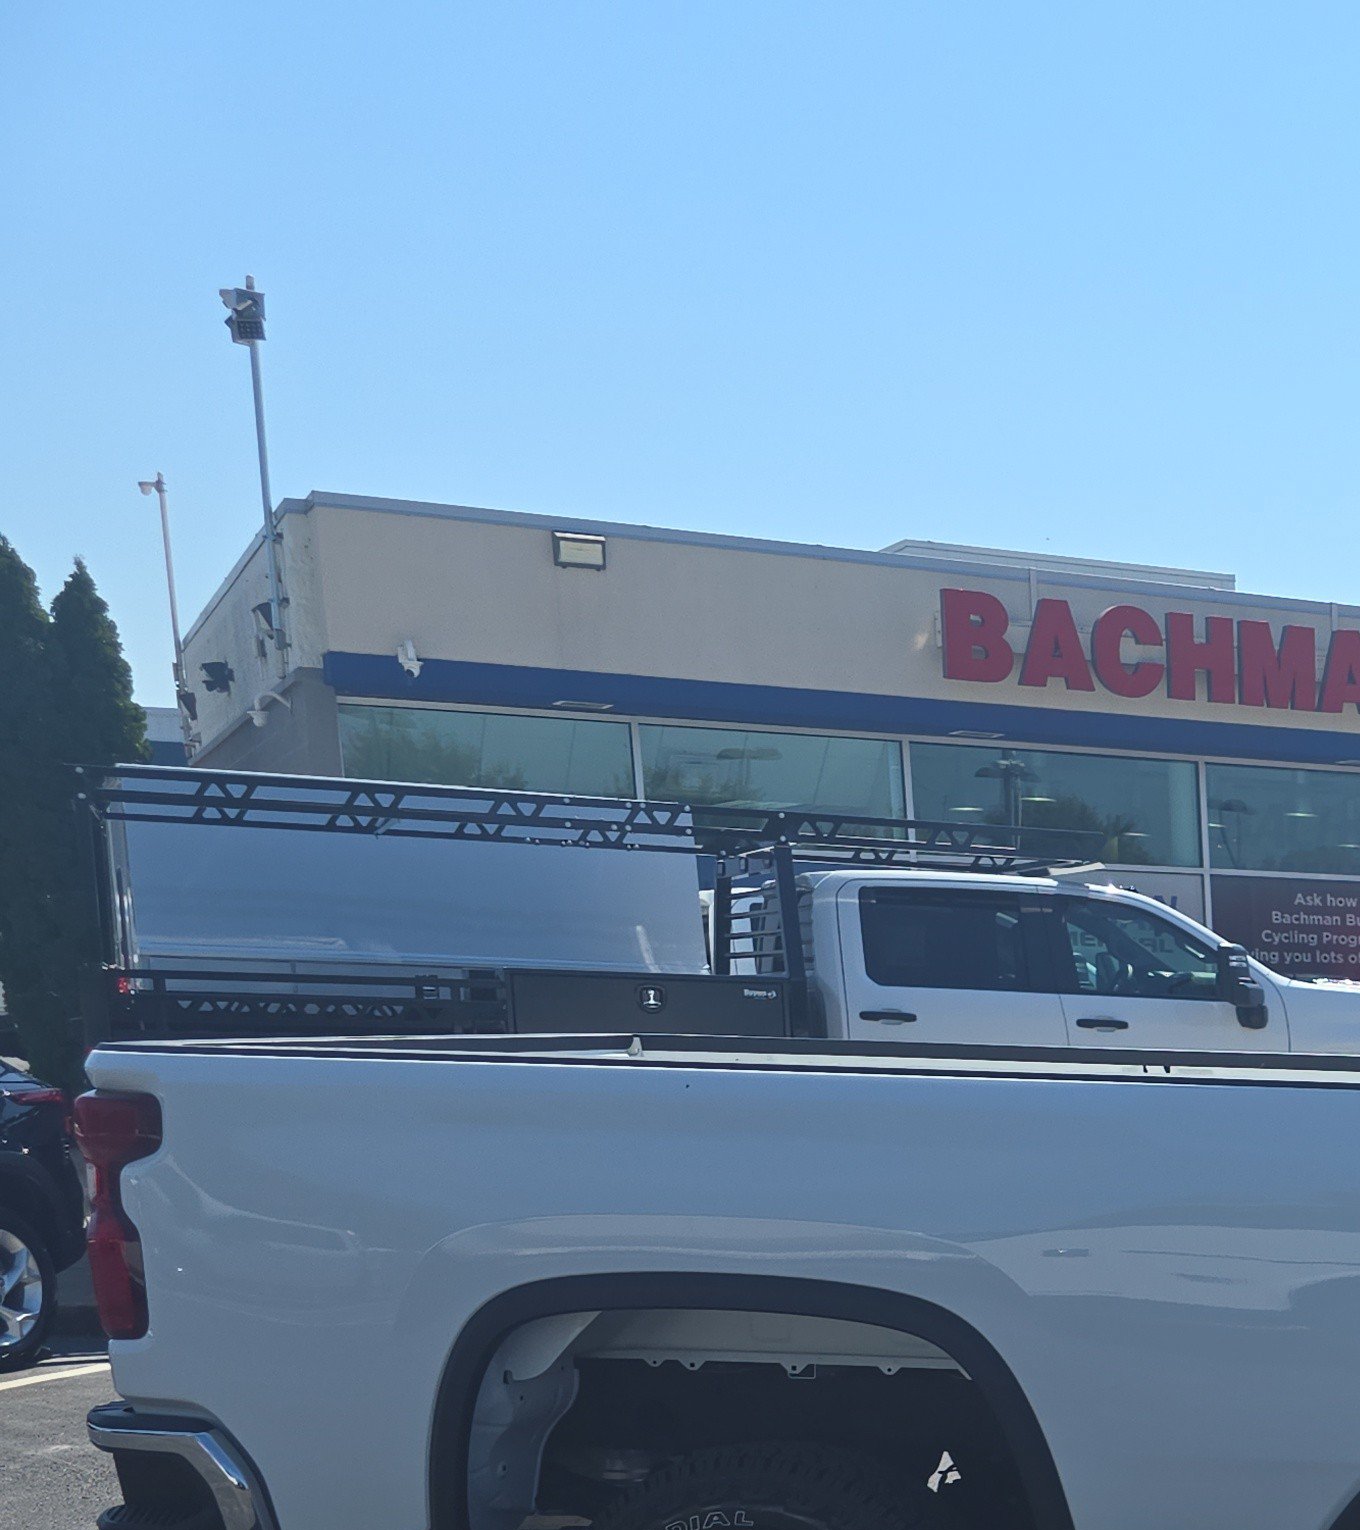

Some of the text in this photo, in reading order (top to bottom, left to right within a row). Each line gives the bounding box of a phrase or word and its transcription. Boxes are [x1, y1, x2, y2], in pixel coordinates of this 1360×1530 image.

[1294, 893, 1322, 907] Ask
[1326, 894, 1359, 909] how
[1271, 911, 1341, 926] Bachman
[1261, 930, 1318, 946] Cycling
[1250, 948, 1279, 963] ing
[1283, 951, 1311, 964] you
[1315, 950, 1344, 963] lots
